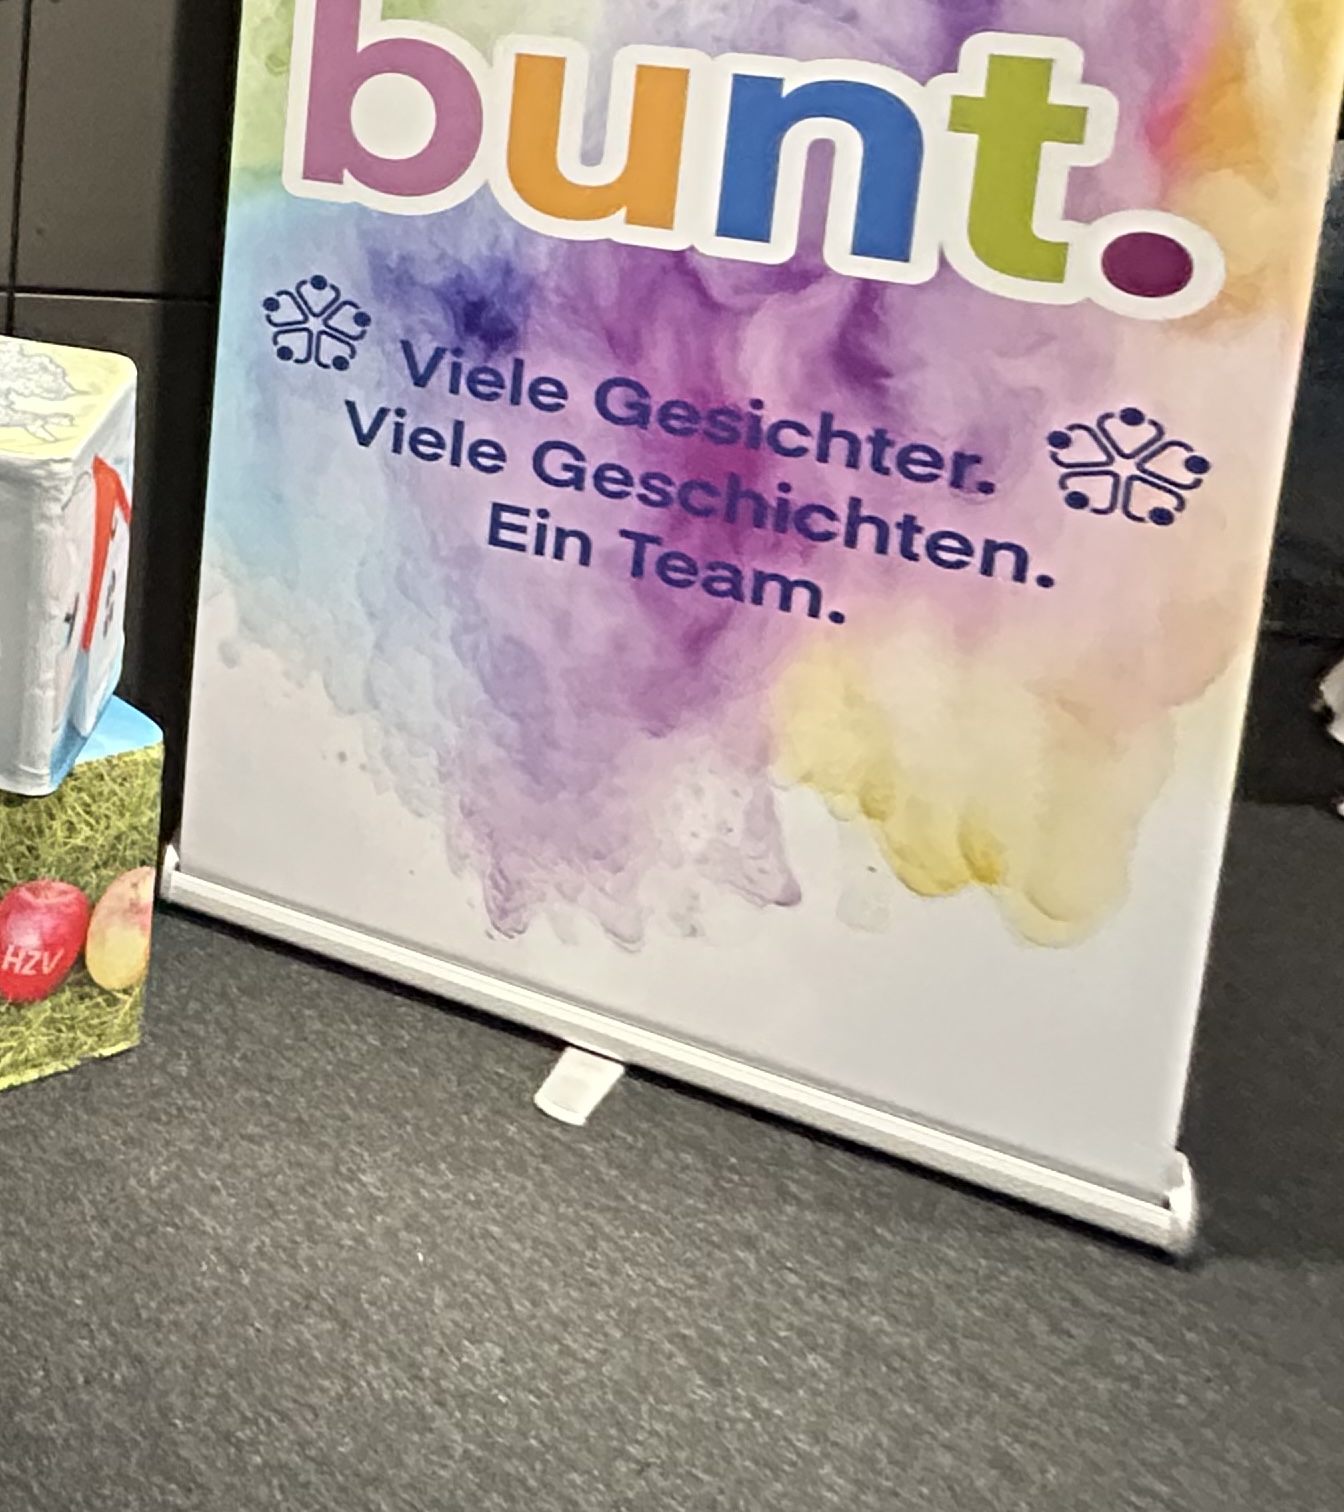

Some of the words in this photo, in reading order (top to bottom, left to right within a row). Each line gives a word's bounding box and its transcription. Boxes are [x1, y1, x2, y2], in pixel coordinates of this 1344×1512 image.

[398, 338, 569, 413] Viele
[594, 376, 996, 496] Gesichter.
[344, 398, 507, 474] Viele
[532, 440, 1055, 589] Geschichten.
[487, 501, 592, 568] Ein
[618, 528, 845, 625] Team.
[1, 944, 65, 976] HZV
